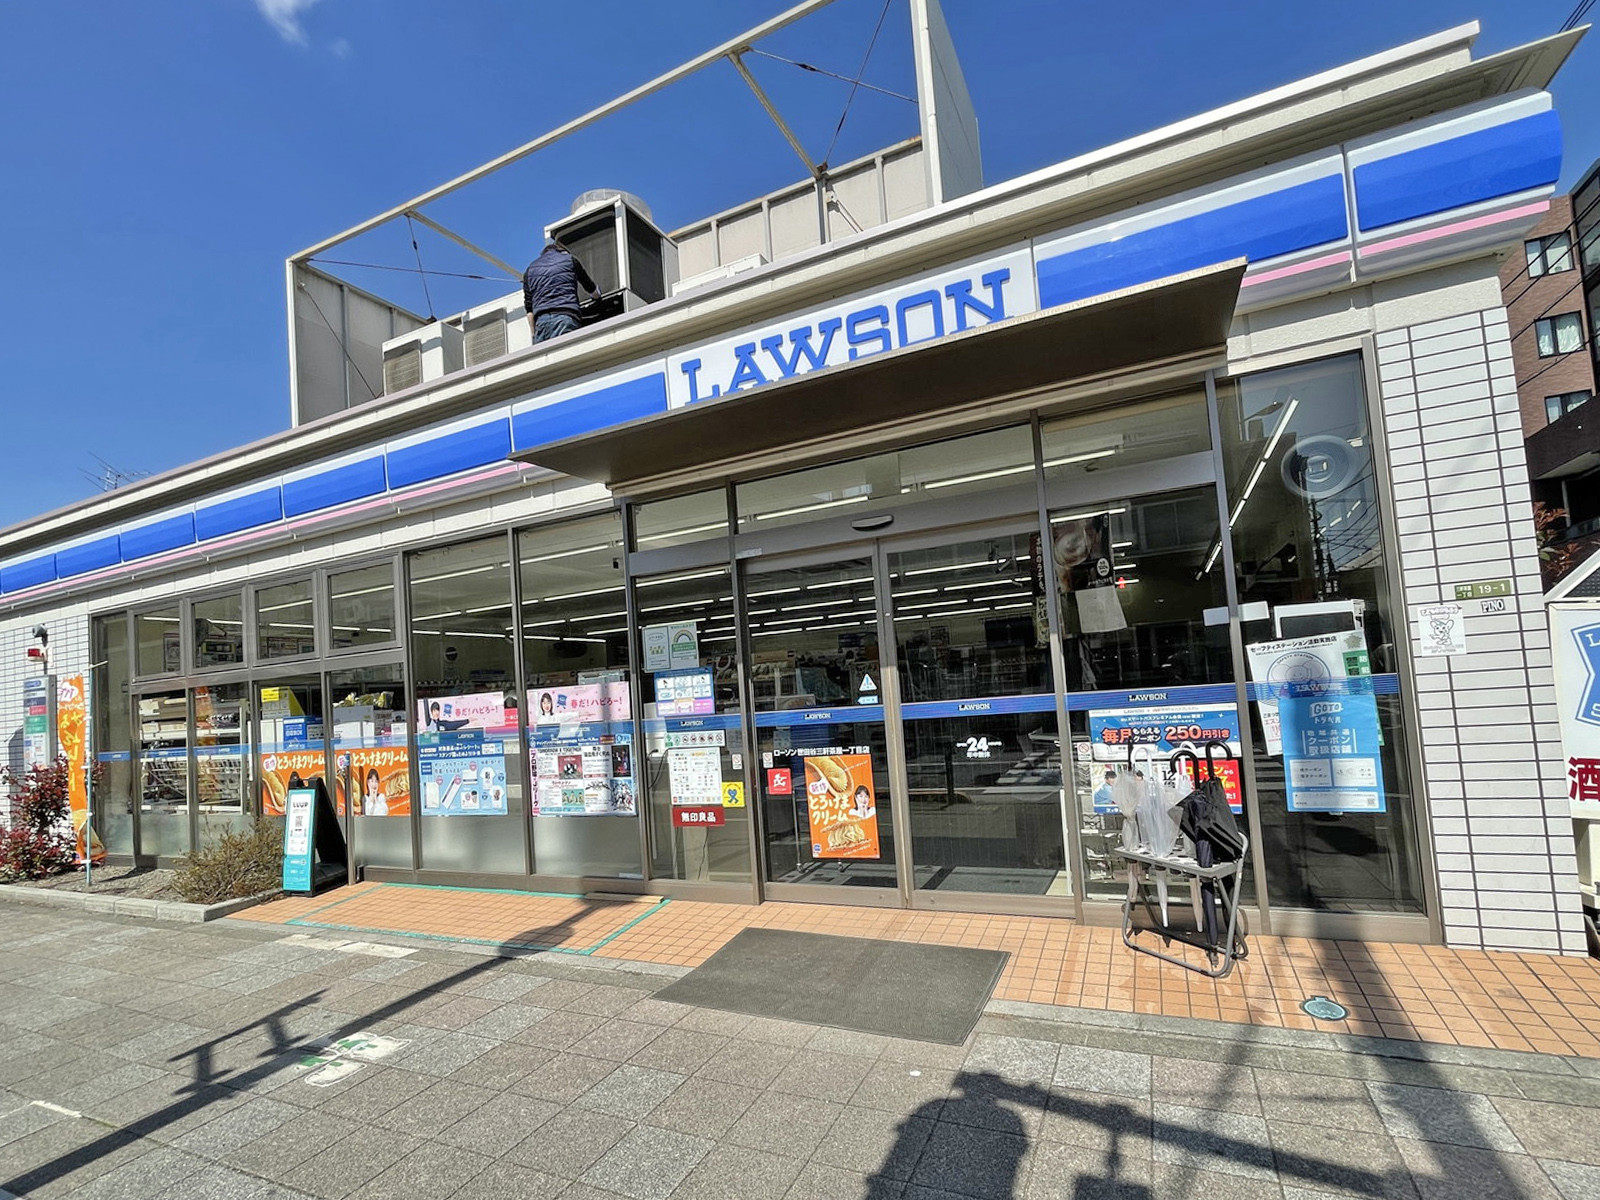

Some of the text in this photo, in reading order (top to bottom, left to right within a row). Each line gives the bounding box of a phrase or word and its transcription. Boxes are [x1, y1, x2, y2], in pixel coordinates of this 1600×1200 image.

[681, 267, 1014, 405] LAWSON
[1479, 583, 1506, 594] 19-1
[1482, 600, 1504, 613] PINO
[1129, 693, 1167, 702] LAWSON
[958, 703, 991, 711] LAWSON
[1102, 727, 1132, 744] 毎月
[1132, 726, 1161, 735] もらえる
[1165, 725, 1231, 741] 250円引き
[1133, 735, 1162, 743] クーポン
[1308, 736, 1351, 745] クーポン
[1309, 745, 1353, 756] 取扱店舗
[681, 811, 716, 822] 無印良品
[812, 810, 849, 826] クリーム
